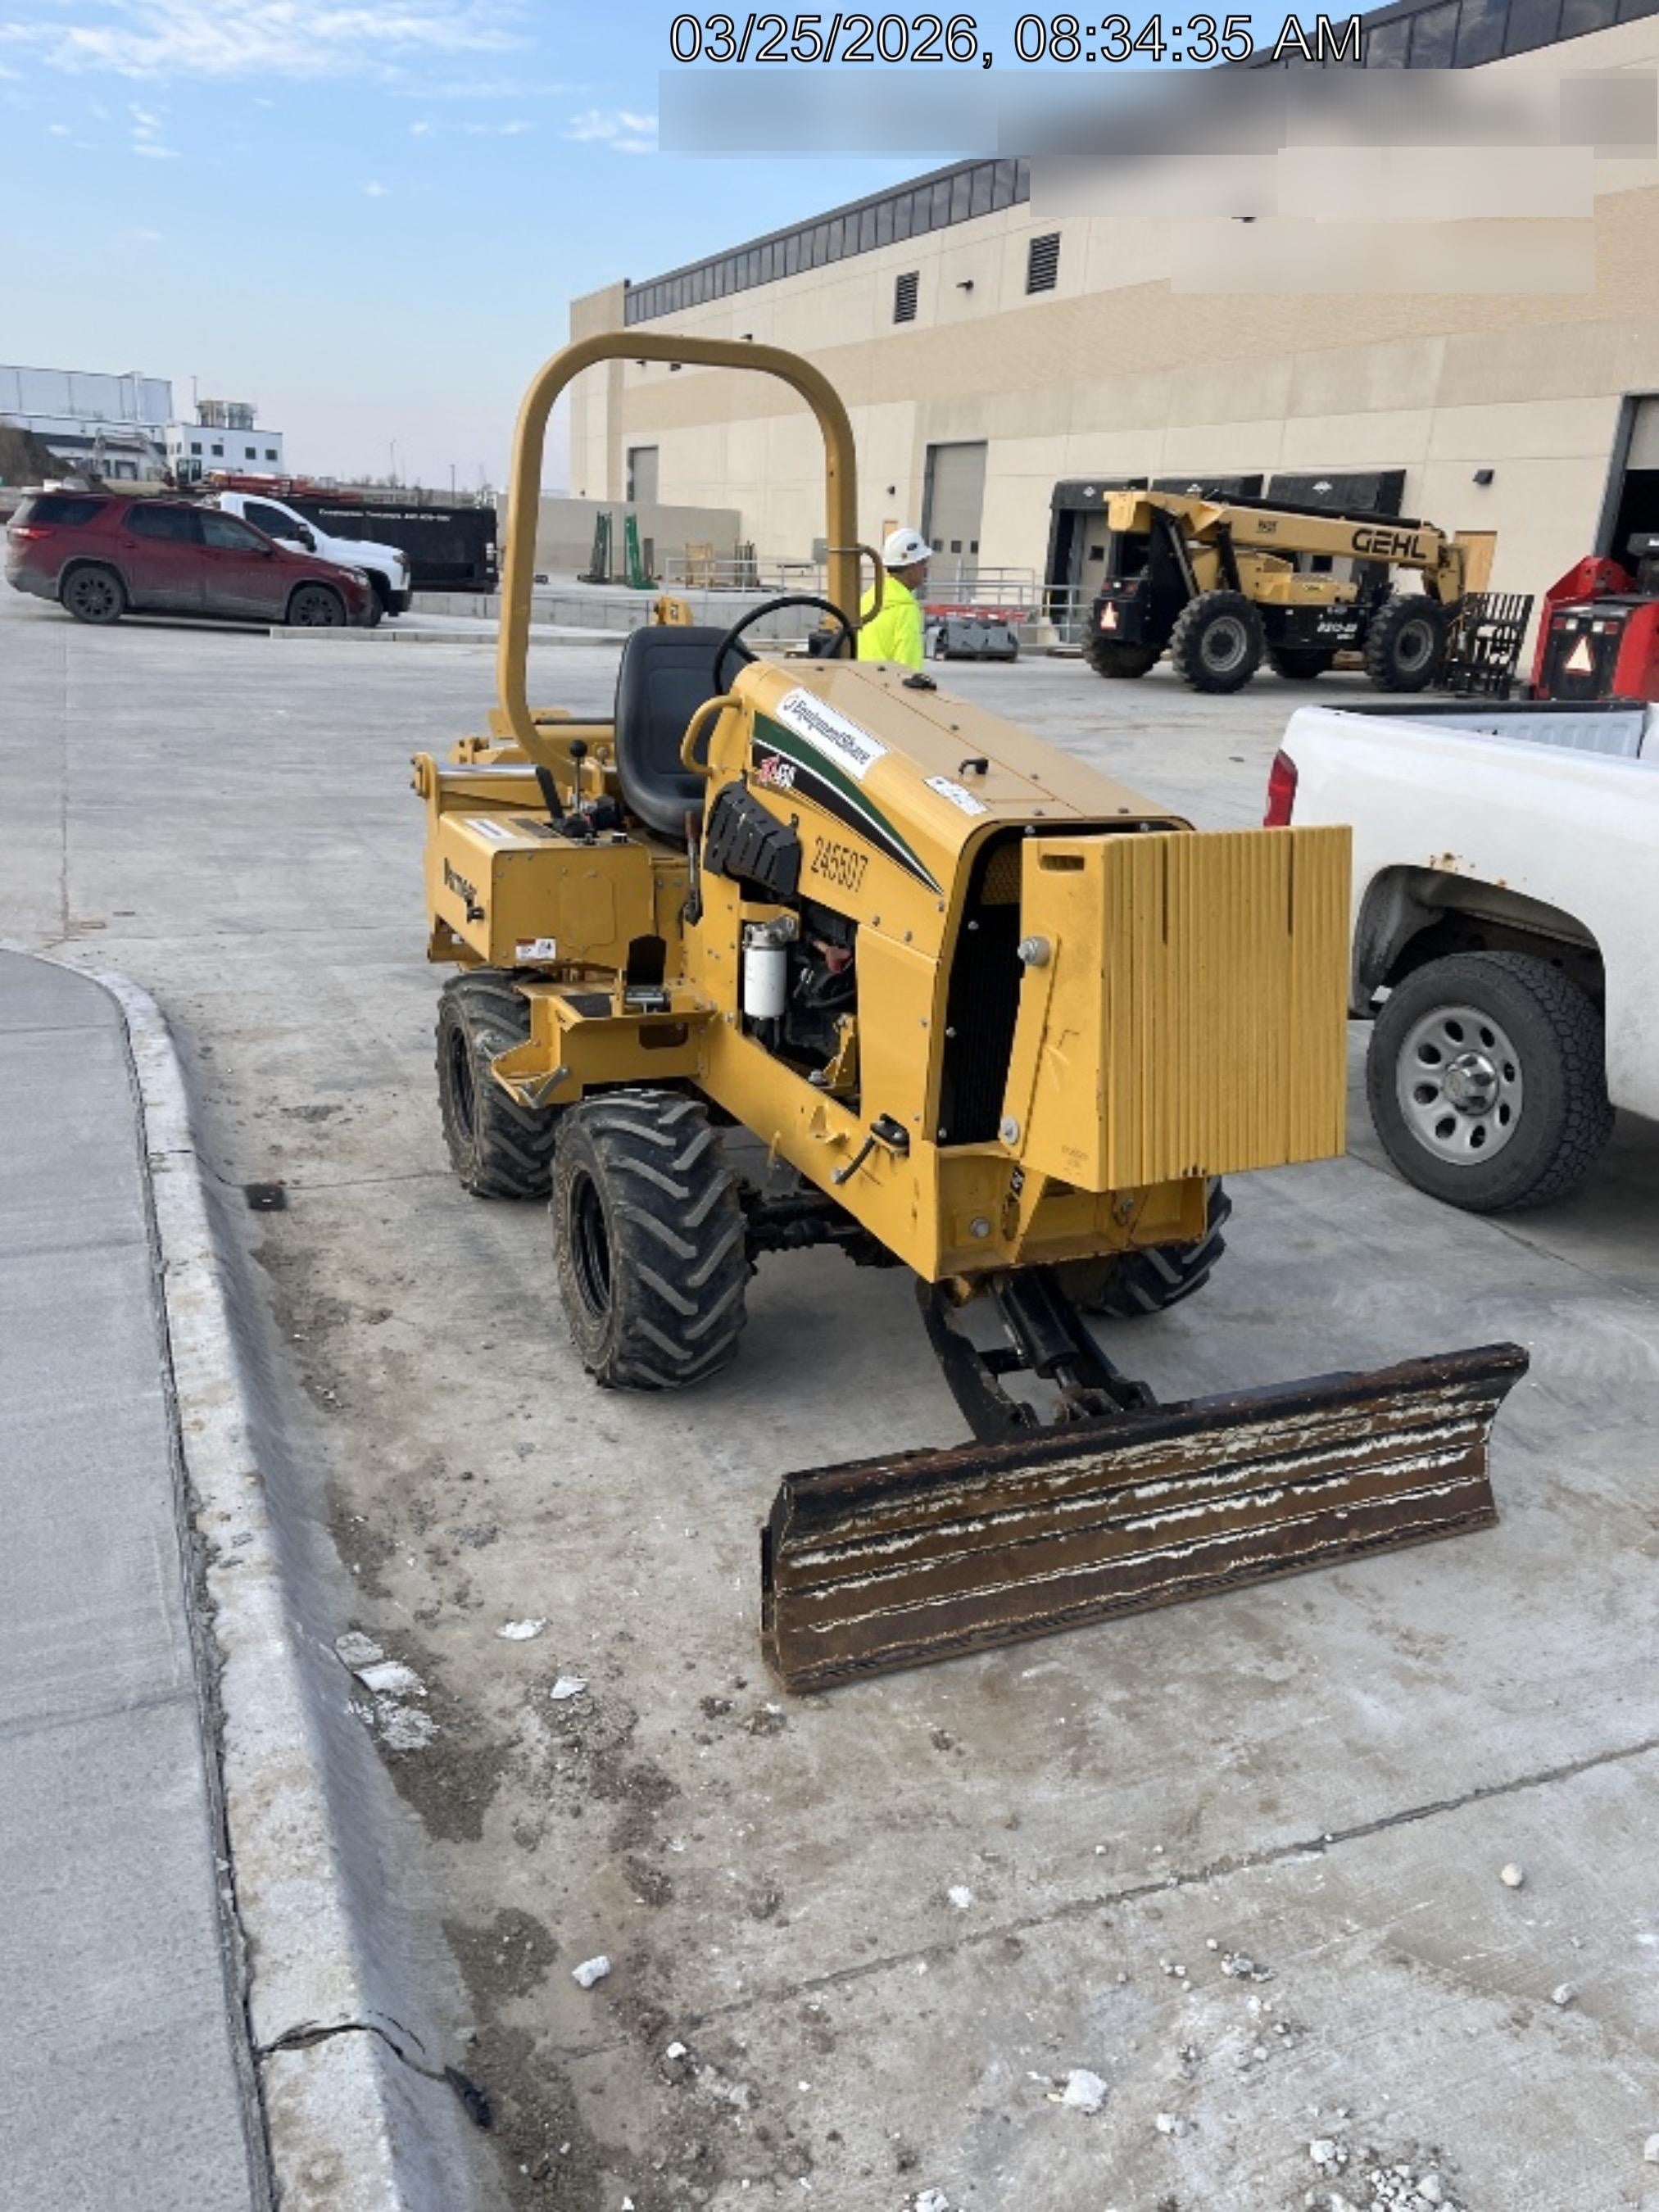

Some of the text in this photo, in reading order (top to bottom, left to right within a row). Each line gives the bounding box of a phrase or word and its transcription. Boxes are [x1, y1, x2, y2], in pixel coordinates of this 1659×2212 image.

[1352, 528, 1426, 560] GEHL
[791, 699, 871, 765] EquipmentShare
[810, 836, 868, 892] 245507
